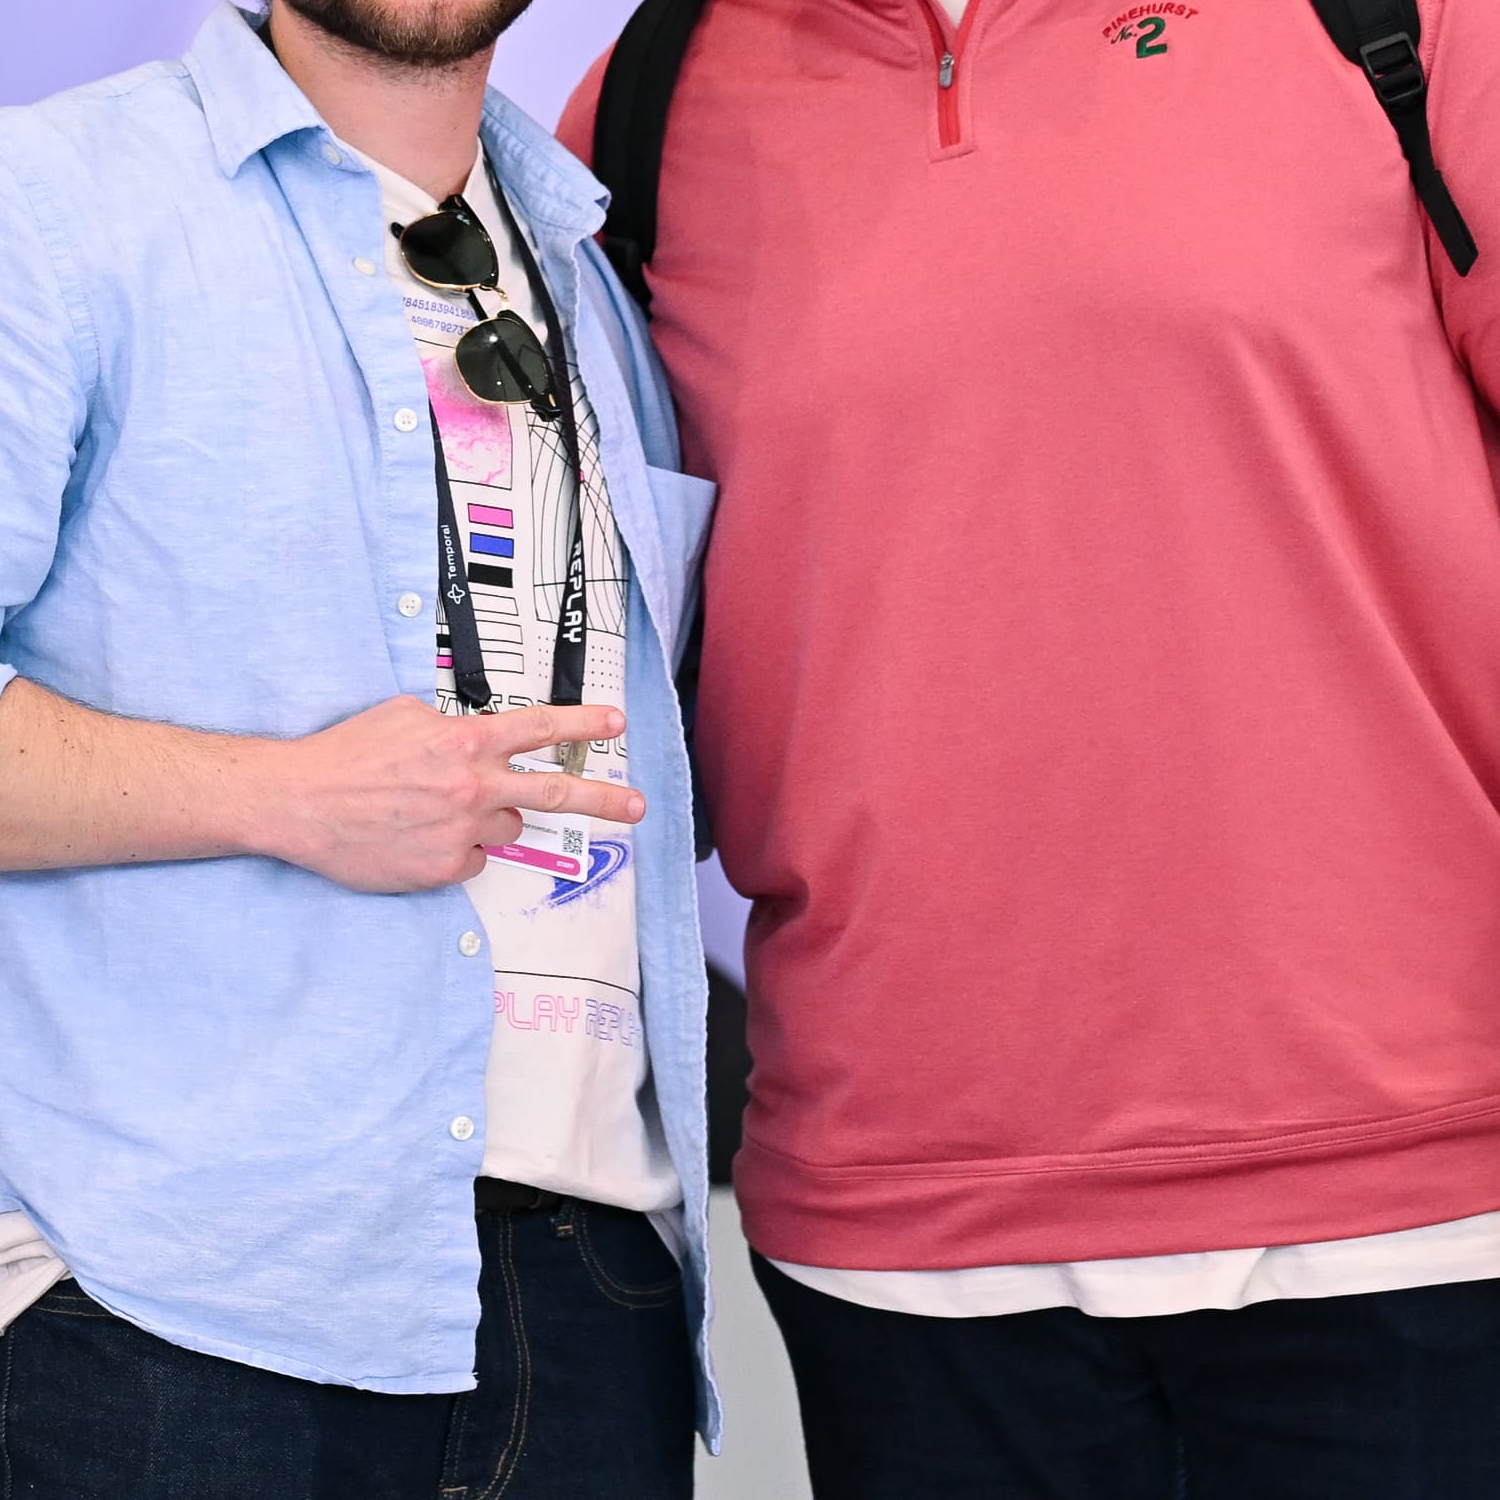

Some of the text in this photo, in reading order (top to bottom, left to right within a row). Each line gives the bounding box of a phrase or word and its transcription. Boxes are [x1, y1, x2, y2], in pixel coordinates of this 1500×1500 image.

[1102, 2, 1199, 38] PINEHURST
[1135, 16, 1168, 59] 2
[440, 524, 458, 580] Temporal
